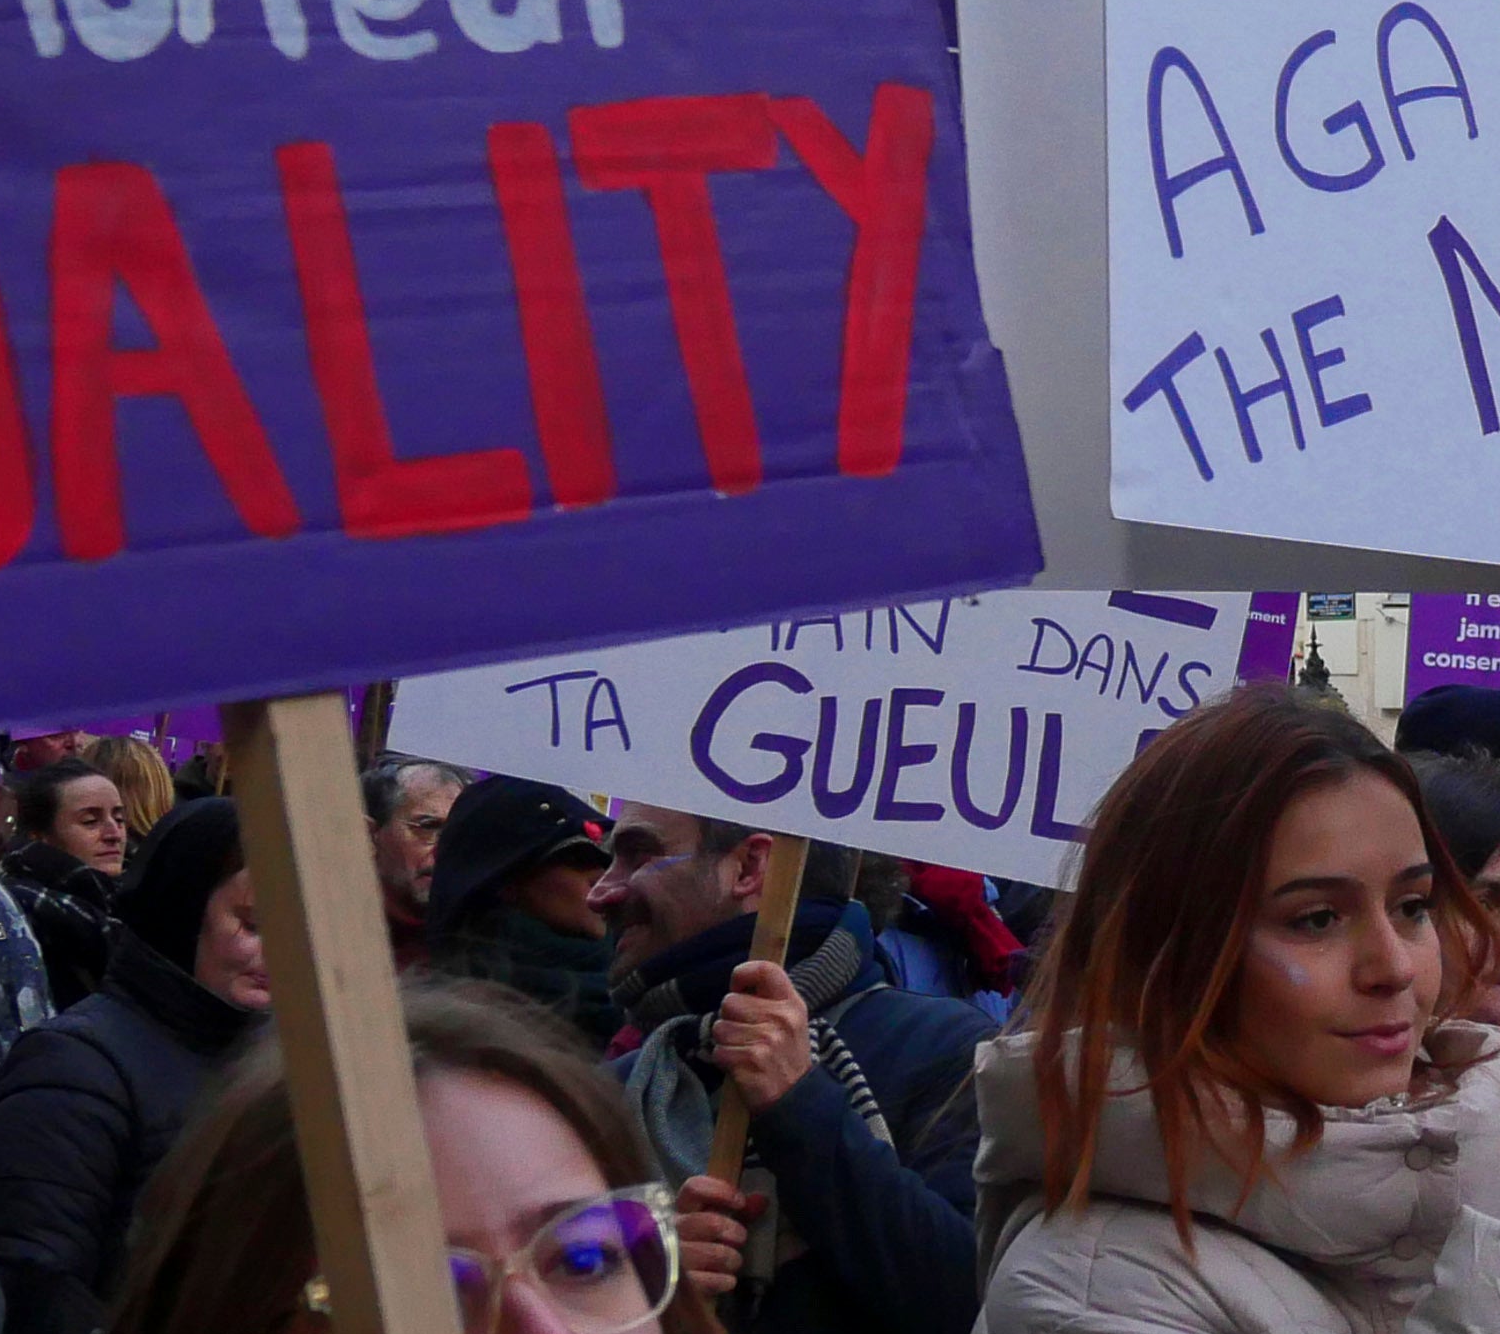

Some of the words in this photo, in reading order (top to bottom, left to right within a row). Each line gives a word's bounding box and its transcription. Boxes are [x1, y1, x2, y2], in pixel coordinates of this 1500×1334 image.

[1123, 294, 1372, 482] THE
[721, 597, 951, 654] AIN
[1016, 617, 1213, 718] DANS
[504, 670, 632, 751] TA
[691, 661, 1162, 844] GUEUL
